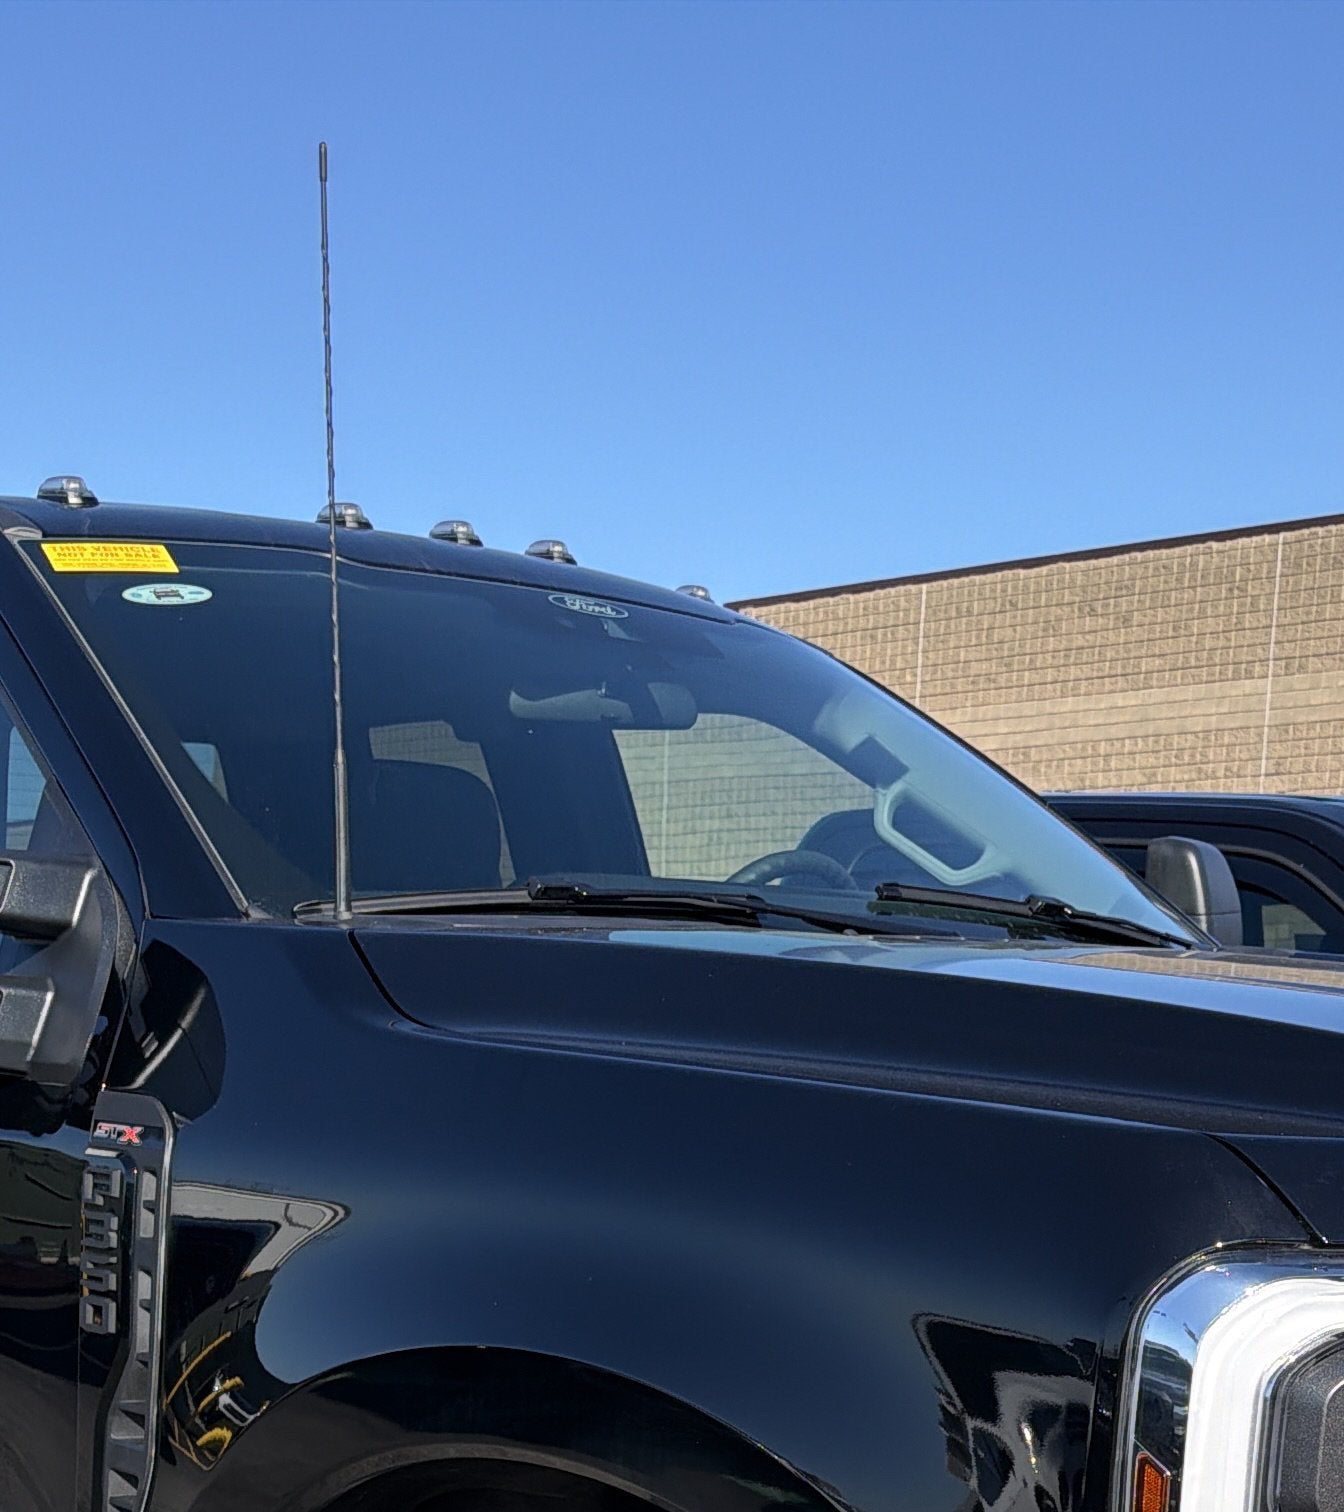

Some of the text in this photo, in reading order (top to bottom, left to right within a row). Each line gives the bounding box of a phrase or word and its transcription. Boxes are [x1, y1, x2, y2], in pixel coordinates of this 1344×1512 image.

[91, 545, 161, 554] VEHICLE
[125, 552, 161, 560] SALE
[563, 595, 617, 616] Ford
[92, 1121, 145, 1147] STX
